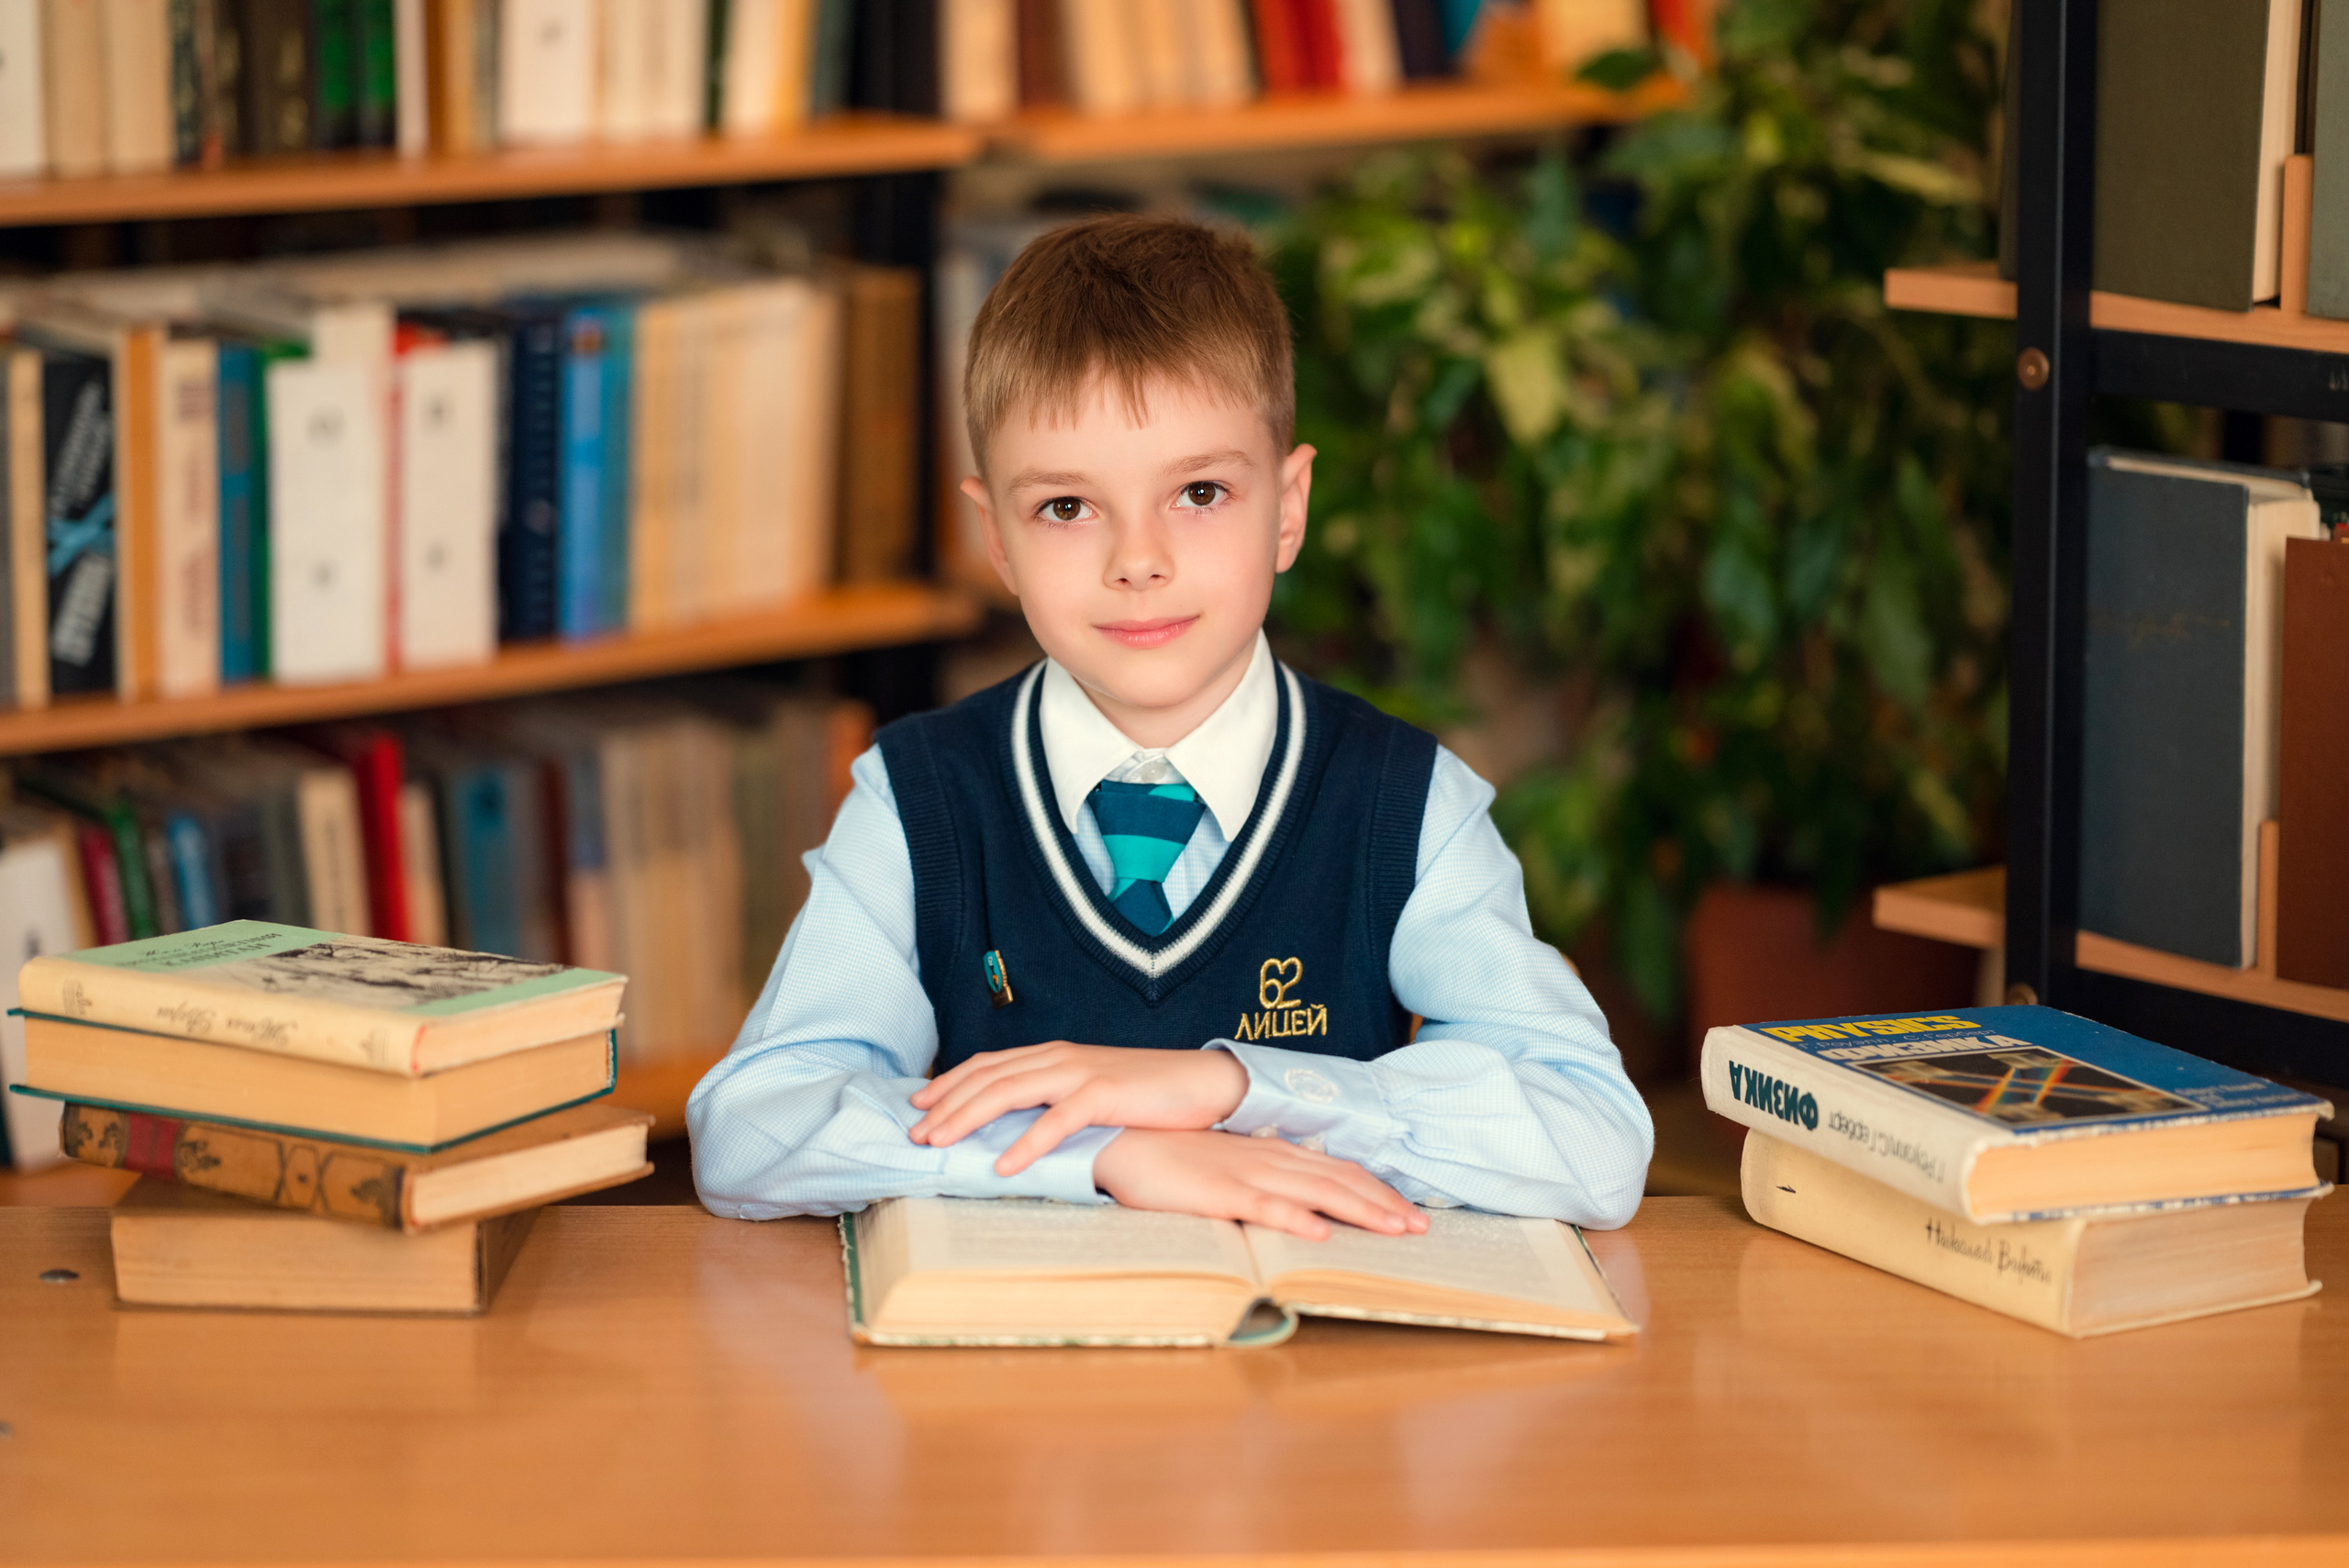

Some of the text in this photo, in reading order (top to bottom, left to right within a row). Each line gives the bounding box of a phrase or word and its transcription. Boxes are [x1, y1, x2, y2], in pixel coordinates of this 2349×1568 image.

[1259, 956, 1303, 1009] 62
[1234, 1003, 1328, 1041] ЛИЦЕЙ
[1759, 1015, 1982, 1042] PHYSICS
[1816, 1034, 2033, 1061] ФИЗИКА
[1728, 1060, 1820, 1131] ФИЗИКА
